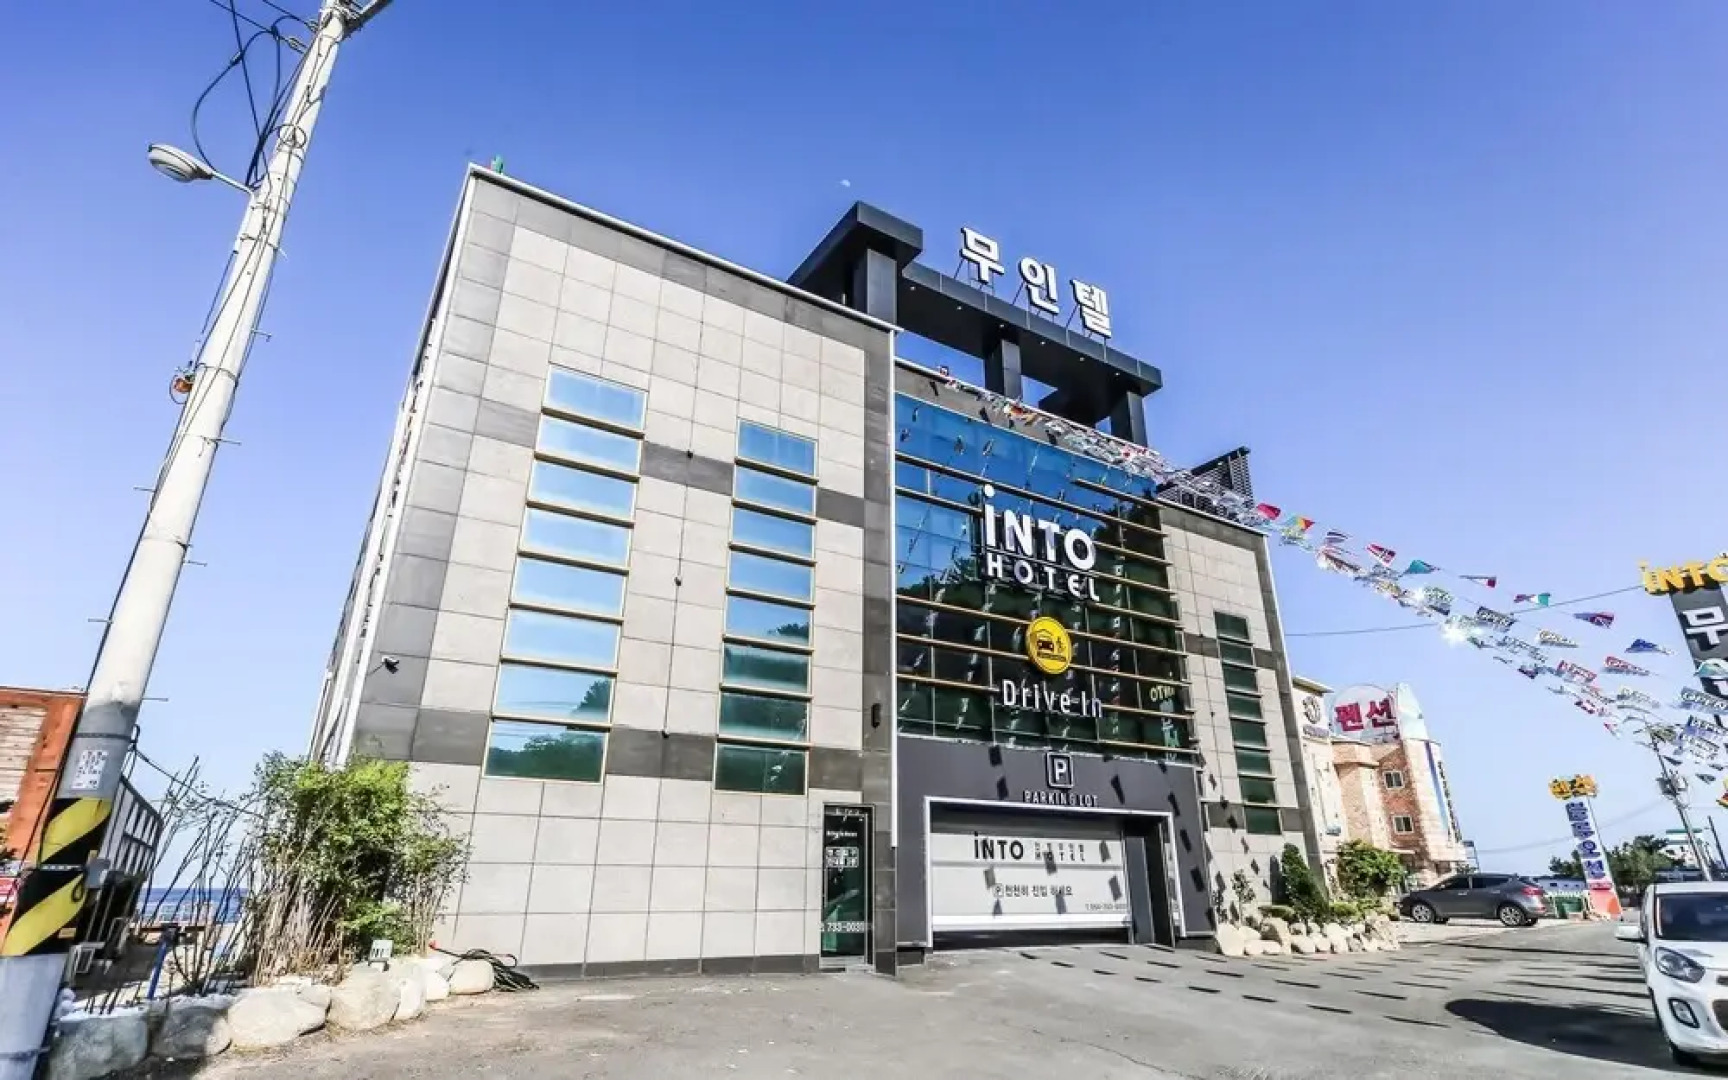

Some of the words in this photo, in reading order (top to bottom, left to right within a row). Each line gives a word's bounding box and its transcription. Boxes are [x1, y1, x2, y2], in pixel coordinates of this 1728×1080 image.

[959, 227, 1112, 338] 무인텔
[986, 552, 1100, 602] HOTEL
[1334, 696, 1396, 732] 펜션
[1054, 758, 1067, 781] P
[1023, 790, 1077, 806] PARKING
[1079, 794, 1098, 807] LOT
